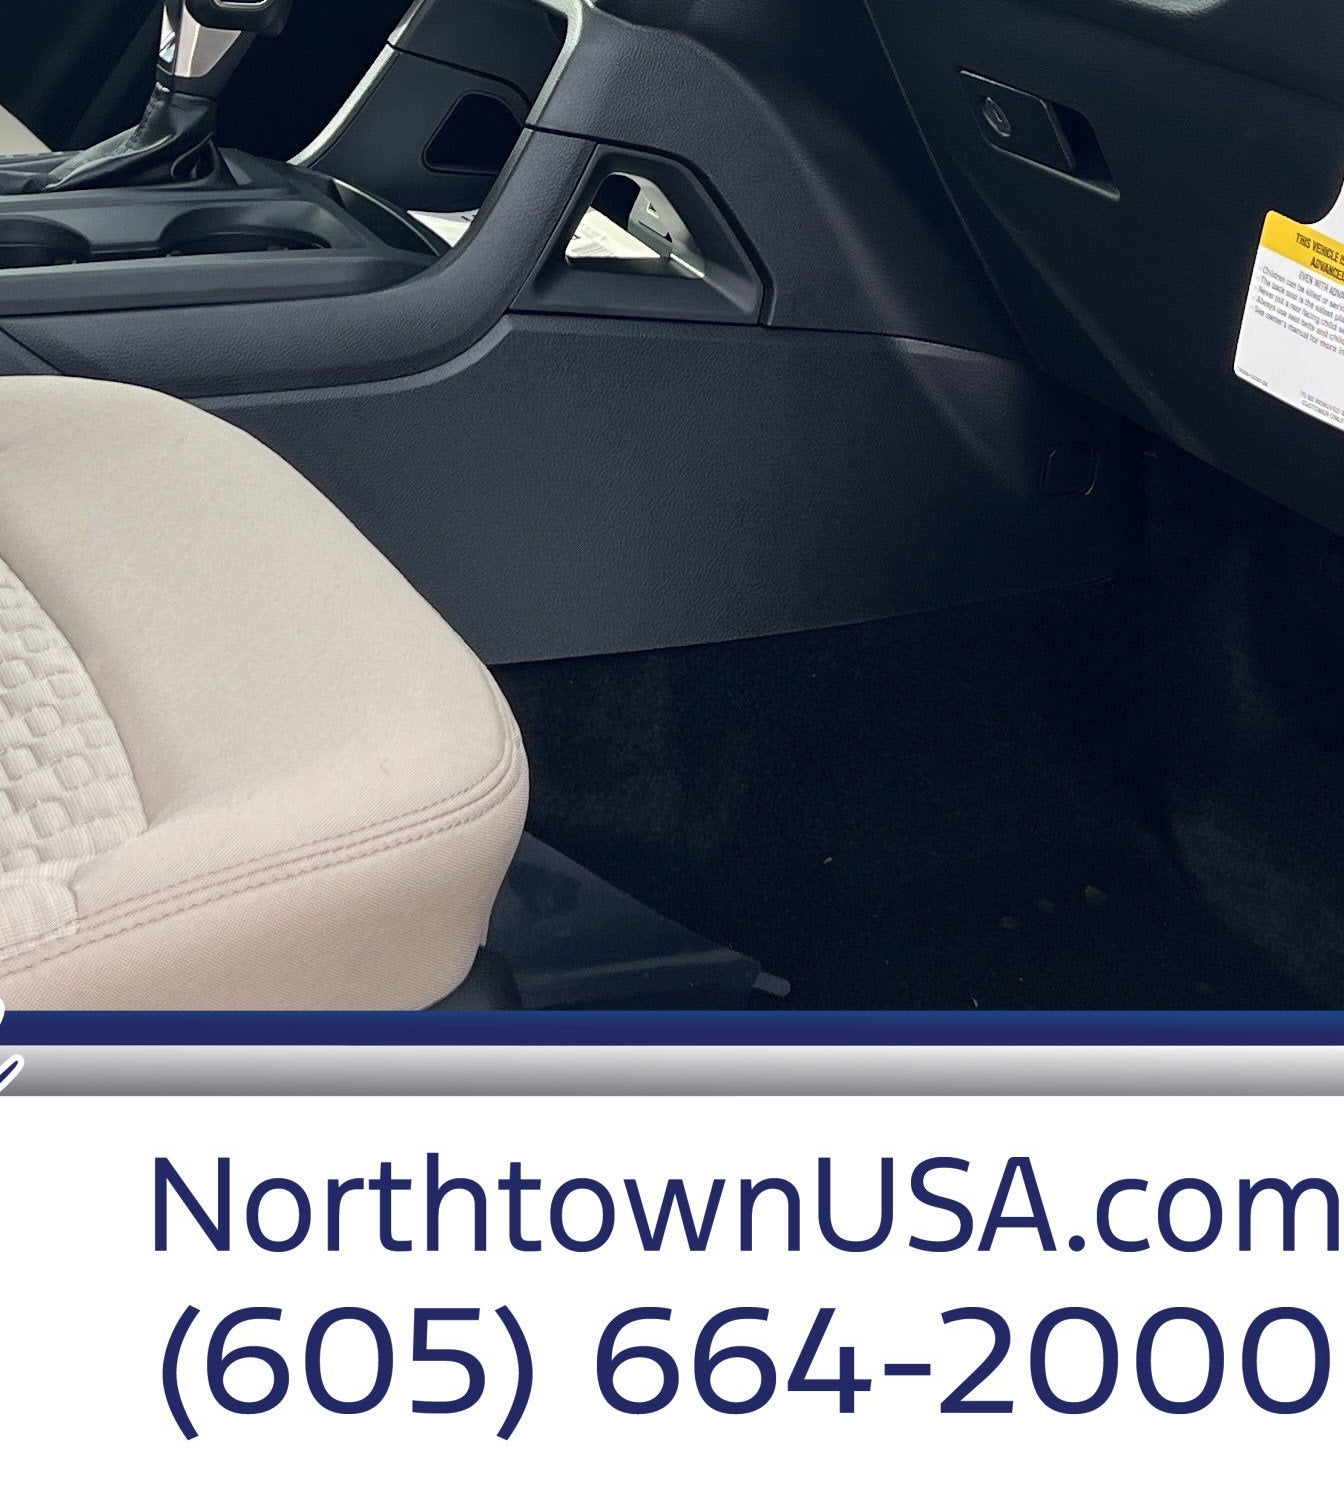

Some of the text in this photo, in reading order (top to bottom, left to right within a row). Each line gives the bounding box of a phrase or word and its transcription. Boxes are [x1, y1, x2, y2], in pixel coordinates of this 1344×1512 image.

[1295, 232, 1311, 249] THIS
[1310, 240, 1339, 262] VEHICLE
[1260, 275, 1271, 286] The
[1304, 298, 1314, 308] the
[1262, 265, 1286, 283] Children
[1285, 278, 1296, 288] can
[1305, 287, 1321, 301] killed
[1255, 295, 1276, 312] Always
[1315, 325, 1328, 338] and
[1258, 285, 1274, 299] Never
[1320, 317, 1337, 331] child
[1309, 333, 1318, 344] for
[1319, 339, 1337, 353] more
